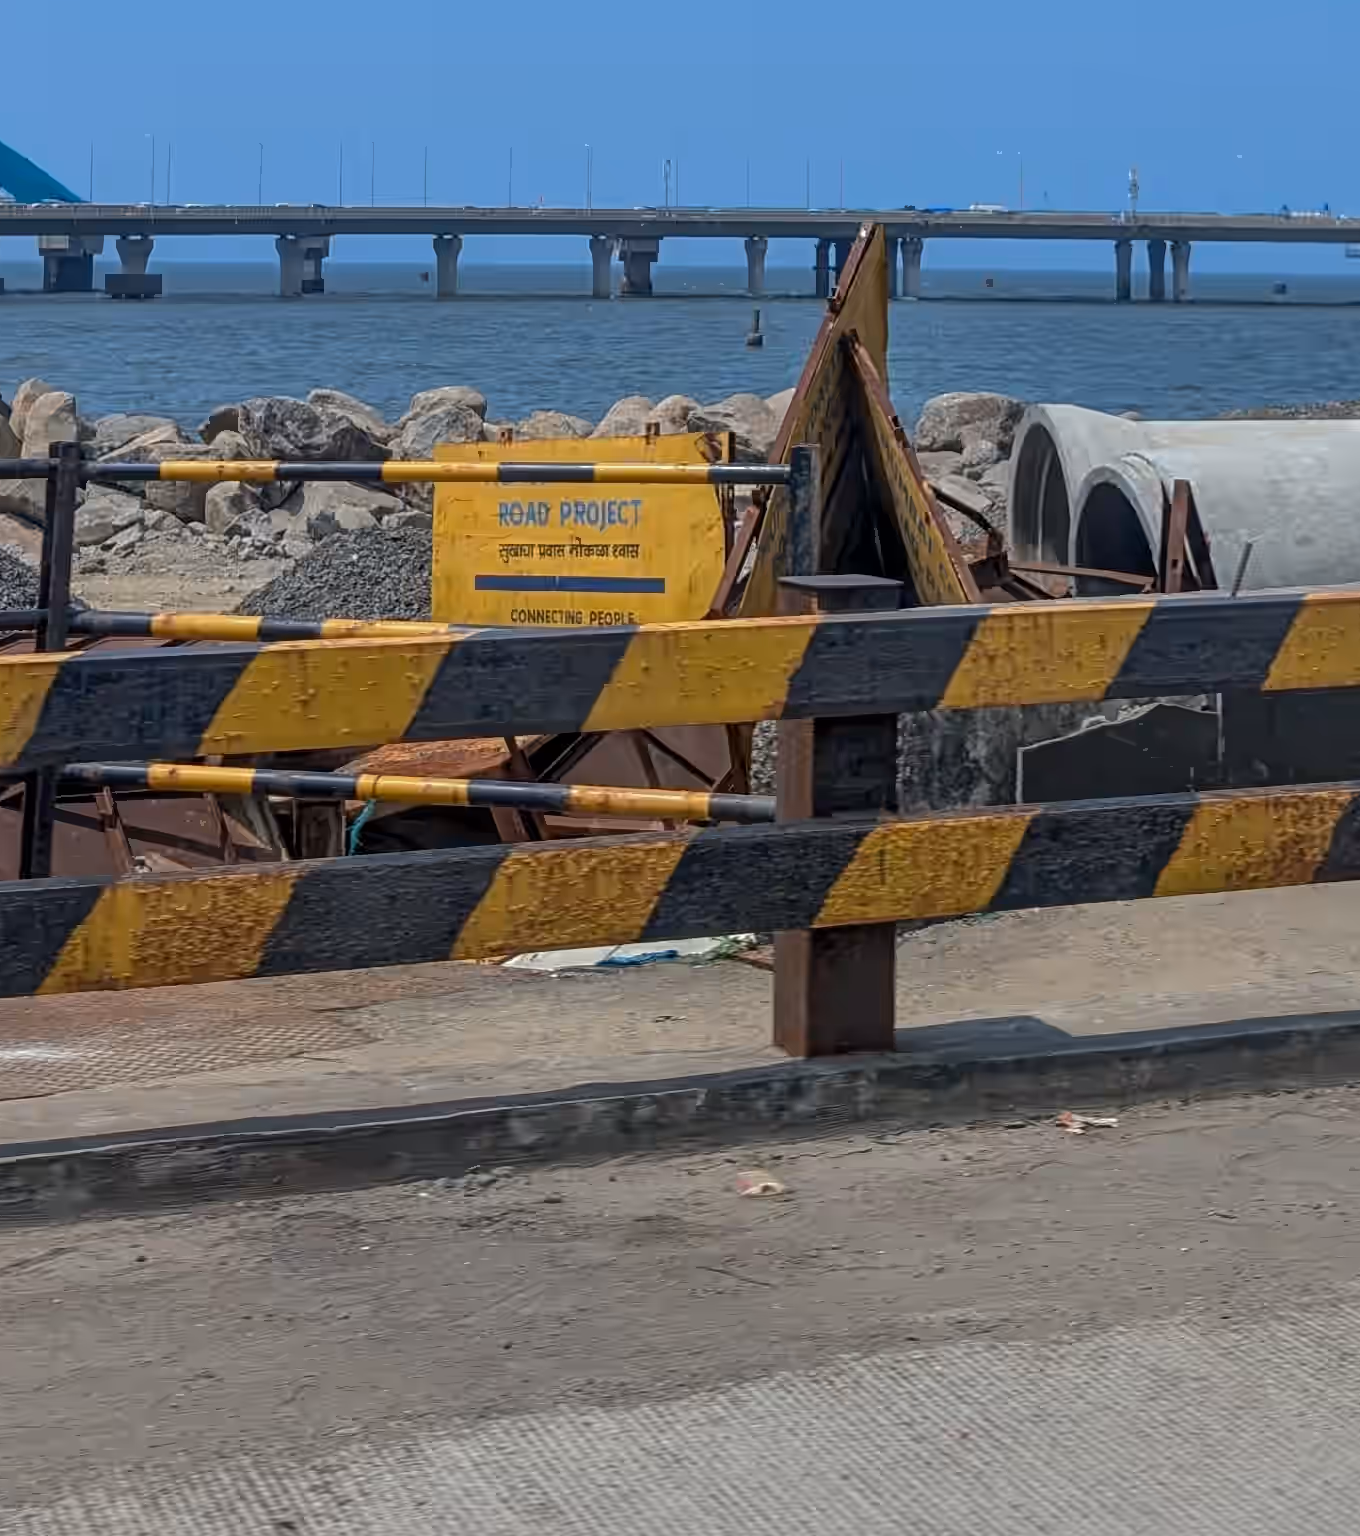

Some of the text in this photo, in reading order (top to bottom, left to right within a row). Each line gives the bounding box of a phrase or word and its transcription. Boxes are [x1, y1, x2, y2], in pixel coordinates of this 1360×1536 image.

[499, 499, 643, 532] ROAD PROJECT
[510, 608, 635, 626] CONNECTING PEOPLE
